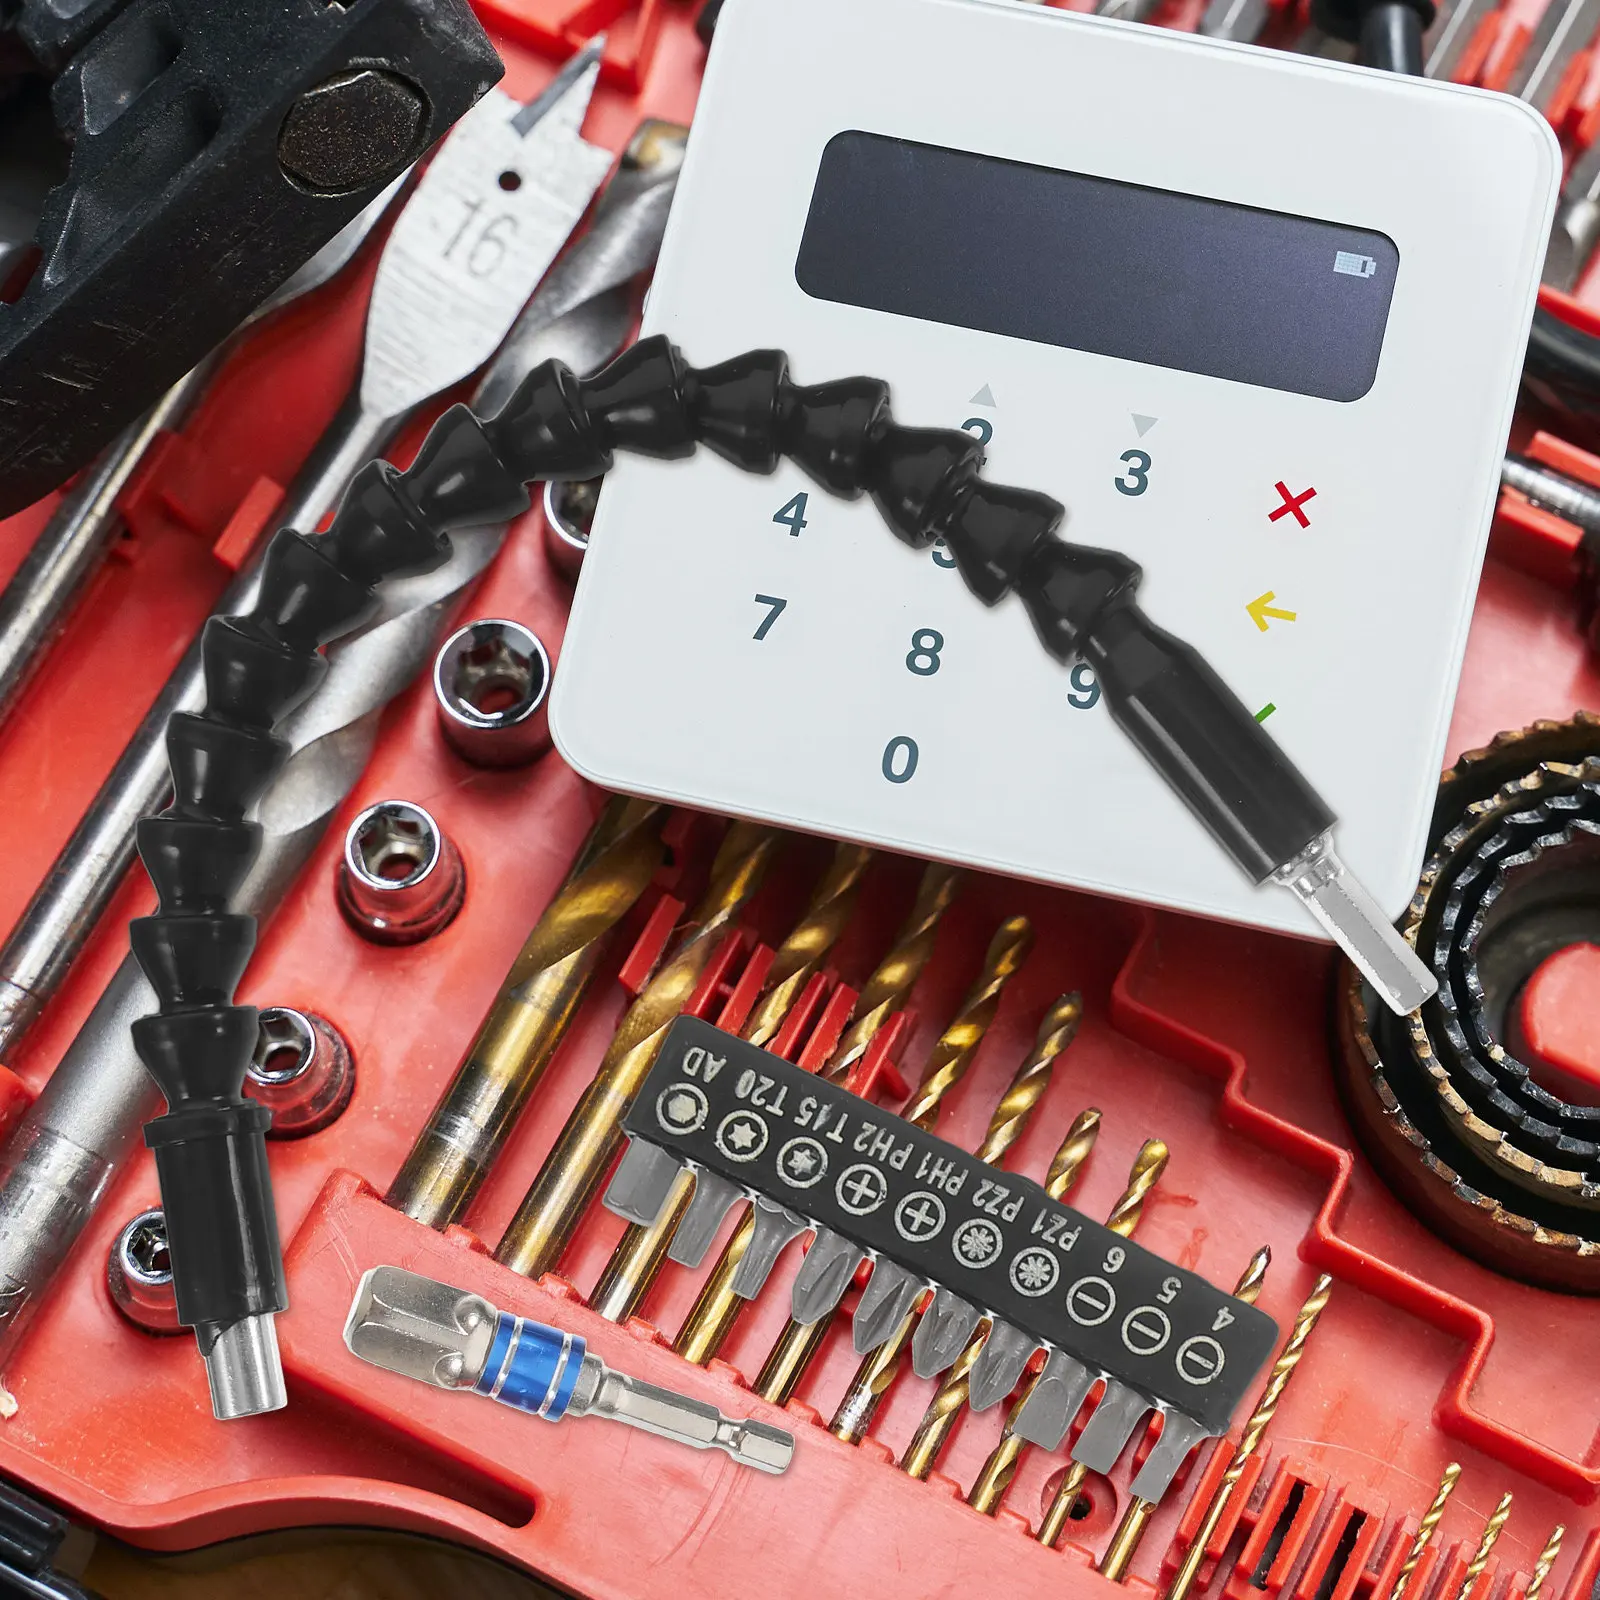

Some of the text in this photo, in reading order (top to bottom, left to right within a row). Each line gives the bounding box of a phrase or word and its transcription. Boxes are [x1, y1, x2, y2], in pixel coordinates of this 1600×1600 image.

[441, 197, 519, 278] 16
[1114, 449, 1153, 497] 3
[772, 492, 809, 537] 4
[752, 594, 1101, 710] 7 8 9
[881, 735, 919, 784] 0
[681, 1046, 727, 1084] AD
[735, 1068, 788, 1117] T20
[852, 1121, 914, 1171] PH2
[914, 1151, 969, 1196] PH1
[972, 1178, 1025, 1223] PZ2
[1030, 1208, 1083, 1251] PZ1
[1102, 1246, 1126, 1274] 6
[1156, 1276, 1183, 1304] 5
[1211, 1306, 1235, 1332] 4
